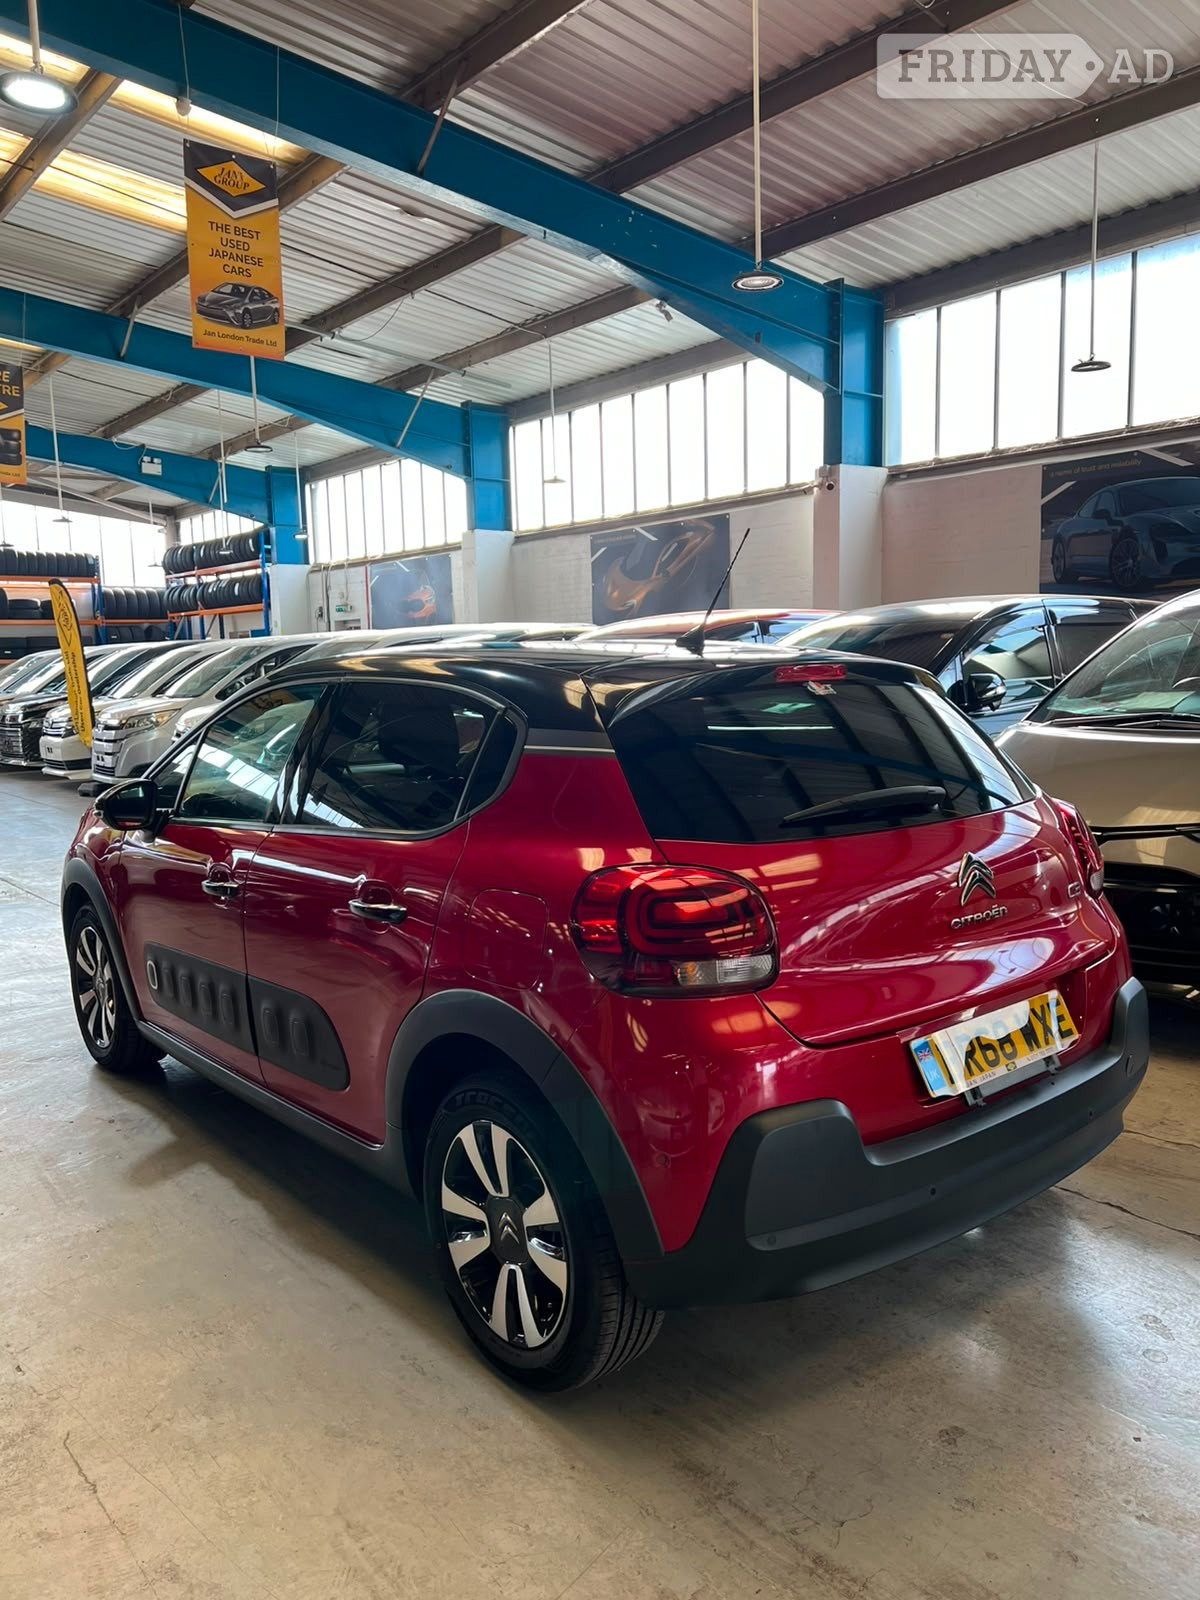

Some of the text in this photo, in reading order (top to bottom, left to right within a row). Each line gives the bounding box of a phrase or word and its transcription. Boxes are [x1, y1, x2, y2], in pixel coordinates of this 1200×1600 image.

[213, 174, 250, 190] GROUP
[207, 220, 261, 240] THE BEST
[220, 236, 250, 252] USED
[208, 247, 264, 267] JAPANESE
[222, 263, 252, 278] CARS
[203, 329, 278, 347] Jan London Trade Ltd
